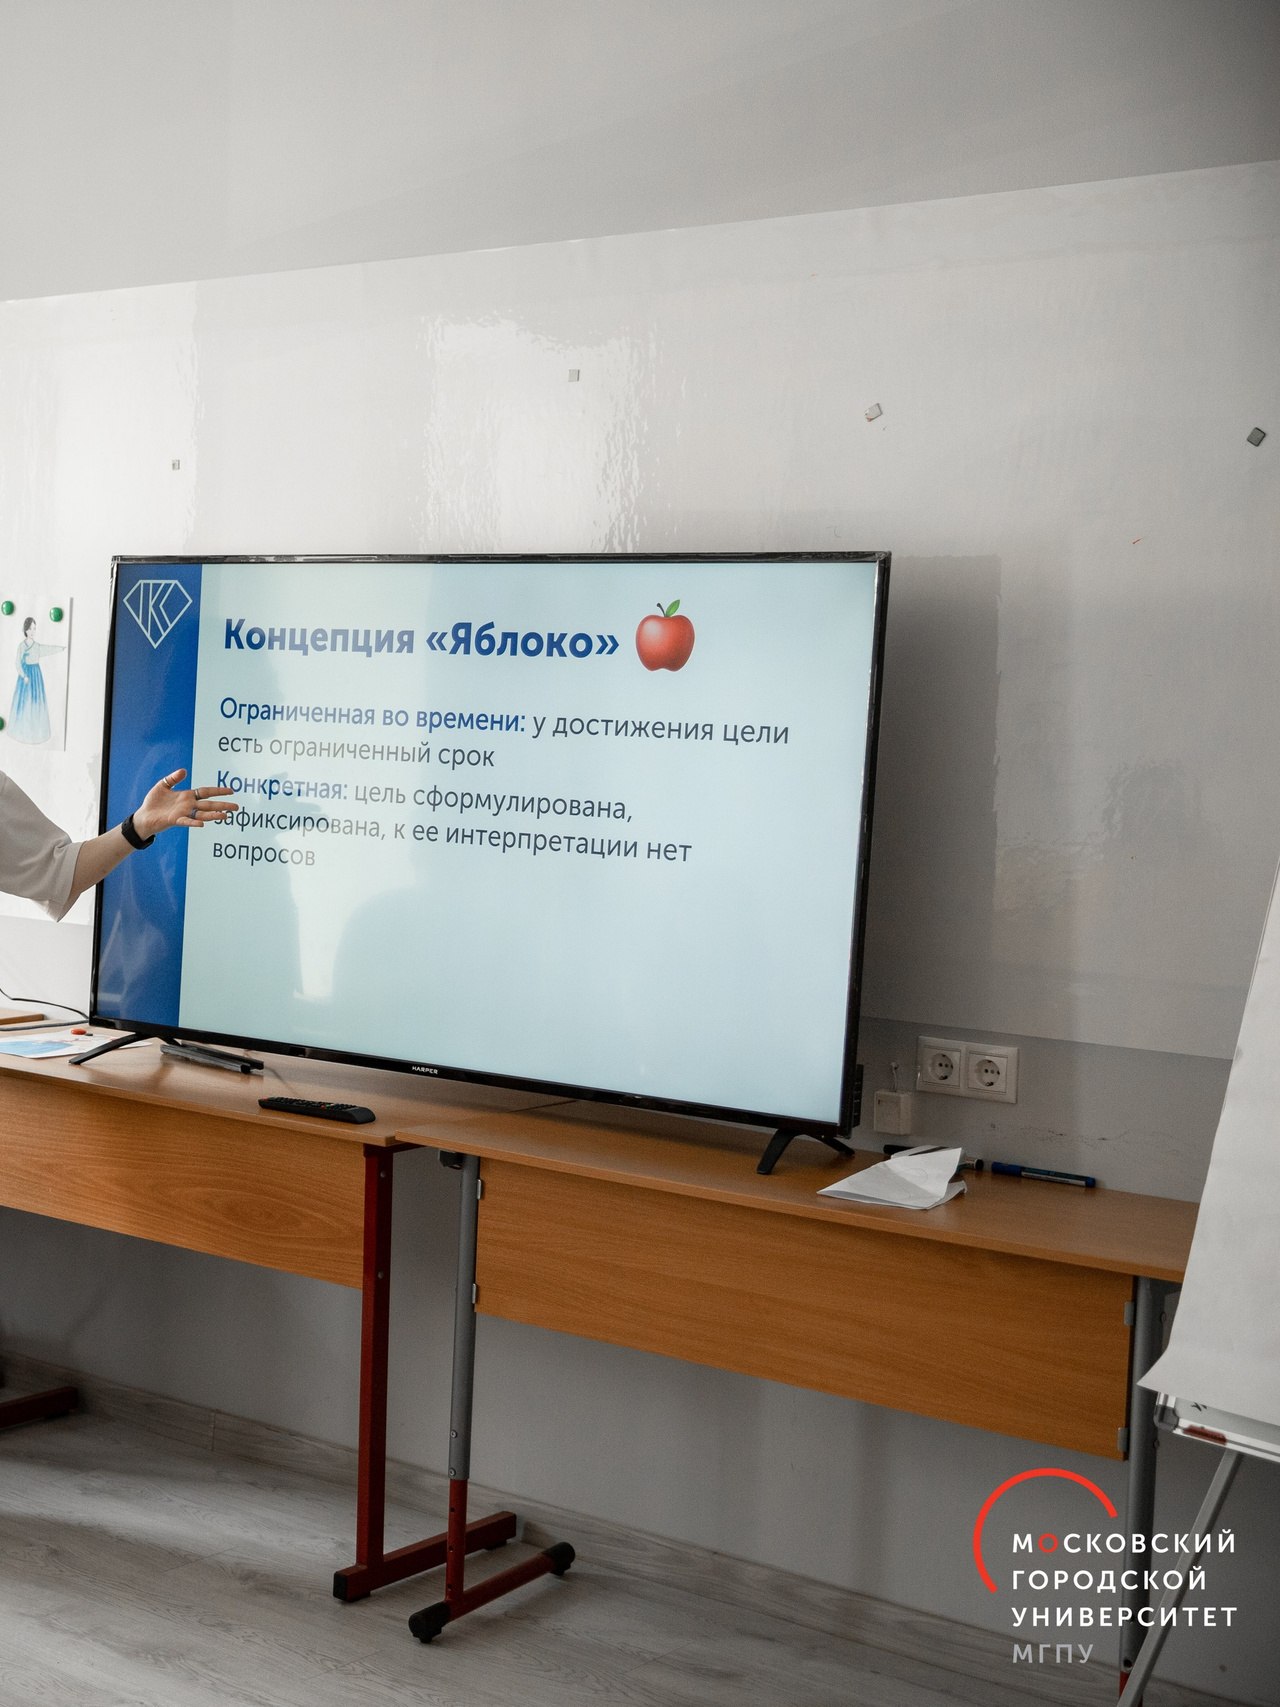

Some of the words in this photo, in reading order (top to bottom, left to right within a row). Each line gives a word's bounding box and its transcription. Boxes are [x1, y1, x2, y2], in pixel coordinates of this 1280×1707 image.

[224, 618, 415, 658] Концепция
[426, 621, 620, 658] «Яблоко»
[220, 697, 376, 725] Ограниченная
[382, 709, 410, 727] во
[416, 710, 526, 733] времени:
[532, 715, 547, 738] у
[552, 716, 714, 741] достижения
[723, 723, 790, 746] цели
[218, 736, 264, 754] есть
[269, 738, 431, 764] ограниченный
[438, 747, 495, 770] срок
[217, 770, 349, 801] Конкретная:
[354, 784, 407, 805] цель
[413, 785, 633, 823] сформулирована,
[212, 842, 316, 866] вопросов
[394, 822, 406, 839] к
[412, 824, 440, 842] ее
[445, 826, 638, 859] интерпретации
[646, 841, 693, 862] нет
